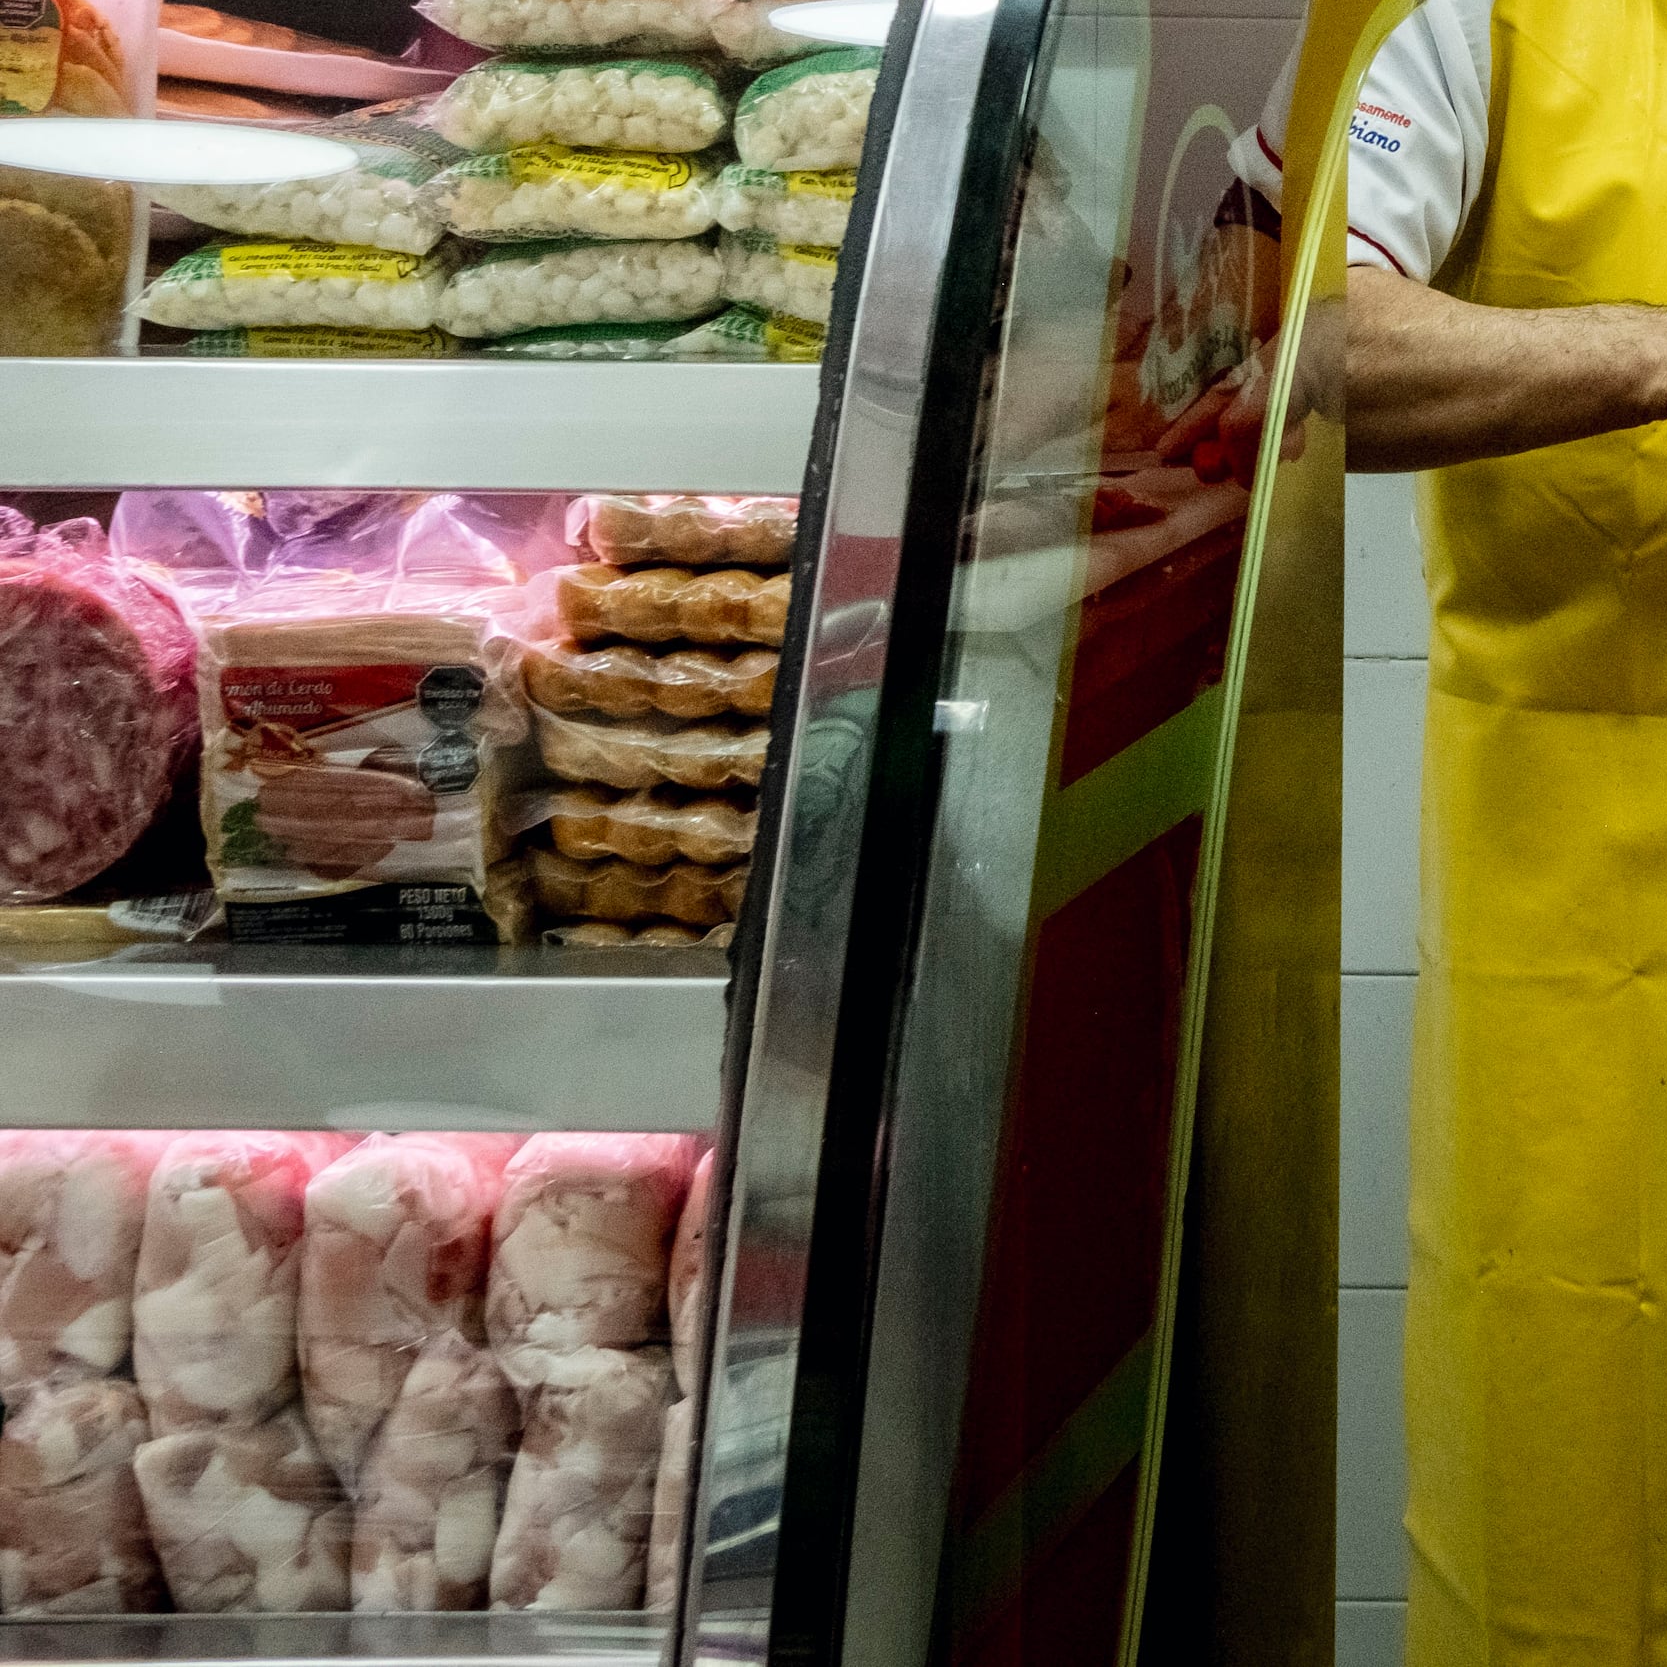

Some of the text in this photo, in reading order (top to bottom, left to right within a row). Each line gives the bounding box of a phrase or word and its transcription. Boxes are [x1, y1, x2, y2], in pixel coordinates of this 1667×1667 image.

[288, 244, 336, 253] PEDIDOS
[265, 679, 284, 696] de
[399, 887, 467, 905] PESO NETO
